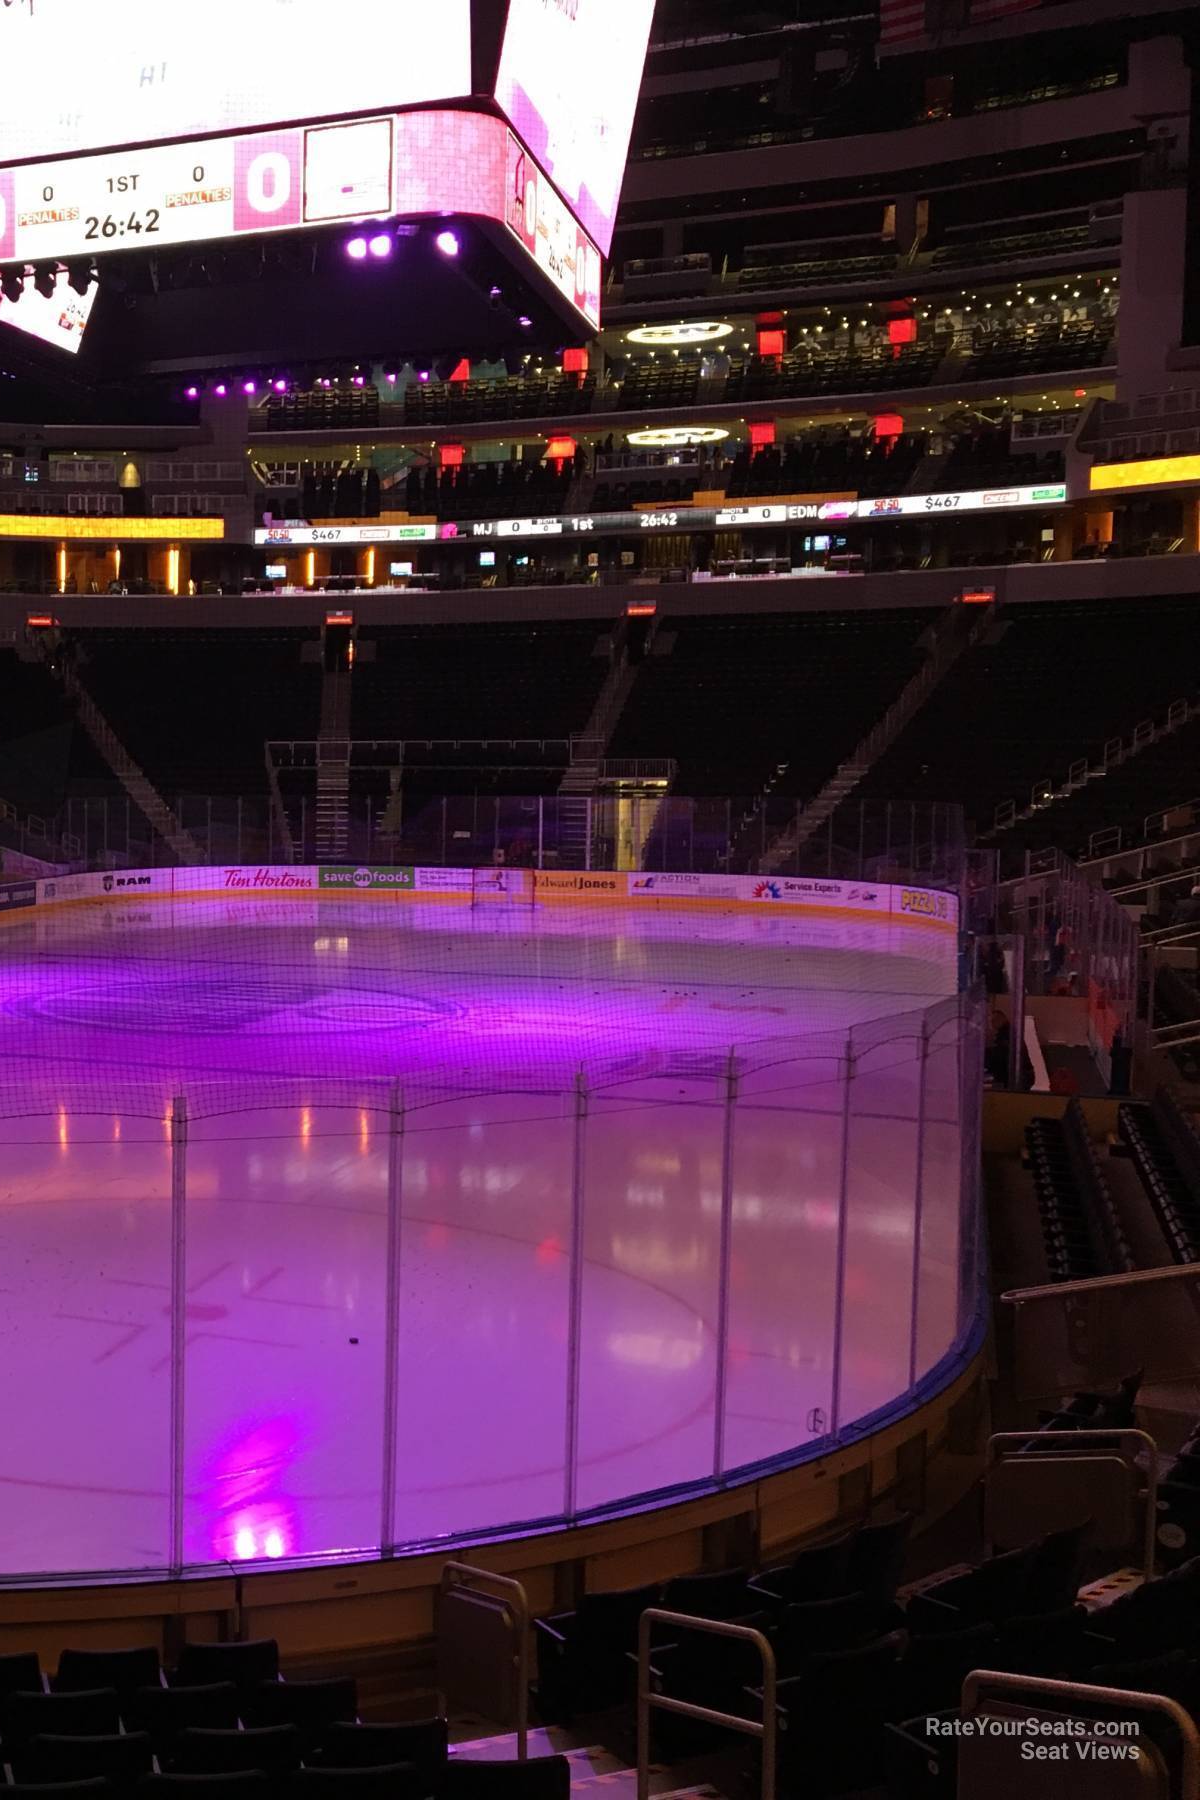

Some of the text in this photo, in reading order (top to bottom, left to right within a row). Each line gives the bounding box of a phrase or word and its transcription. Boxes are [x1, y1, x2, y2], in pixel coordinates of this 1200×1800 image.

[193, 165, 205, 182] 0
[106, 174, 140, 193] 1ST
[247, 152, 291, 213] 0
[42, 186, 54, 202] 0
[166, 187, 232, 207] PENALTIES
[17, 206, 80, 226] PENALTIES
[84, 208, 160, 240] 26:42
[925, 496, 961, 510] $467
[640, 512, 678, 527] 26:42
[762, 509, 771, 519] 0
[789, 505, 818, 519] EDM
[473, 523, 493, 535] MJ
[512, 522, 520, 532] 0
[571, 518, 594, 531] 1st
[311, 529, 341, 541] $467
[117, 876, 151, 887] RAM
[224, 868, 312, 888] Tim Hortons
[784, 881, 842, 894] Service Experts
[901, 889, 936, 913] PIZZA
